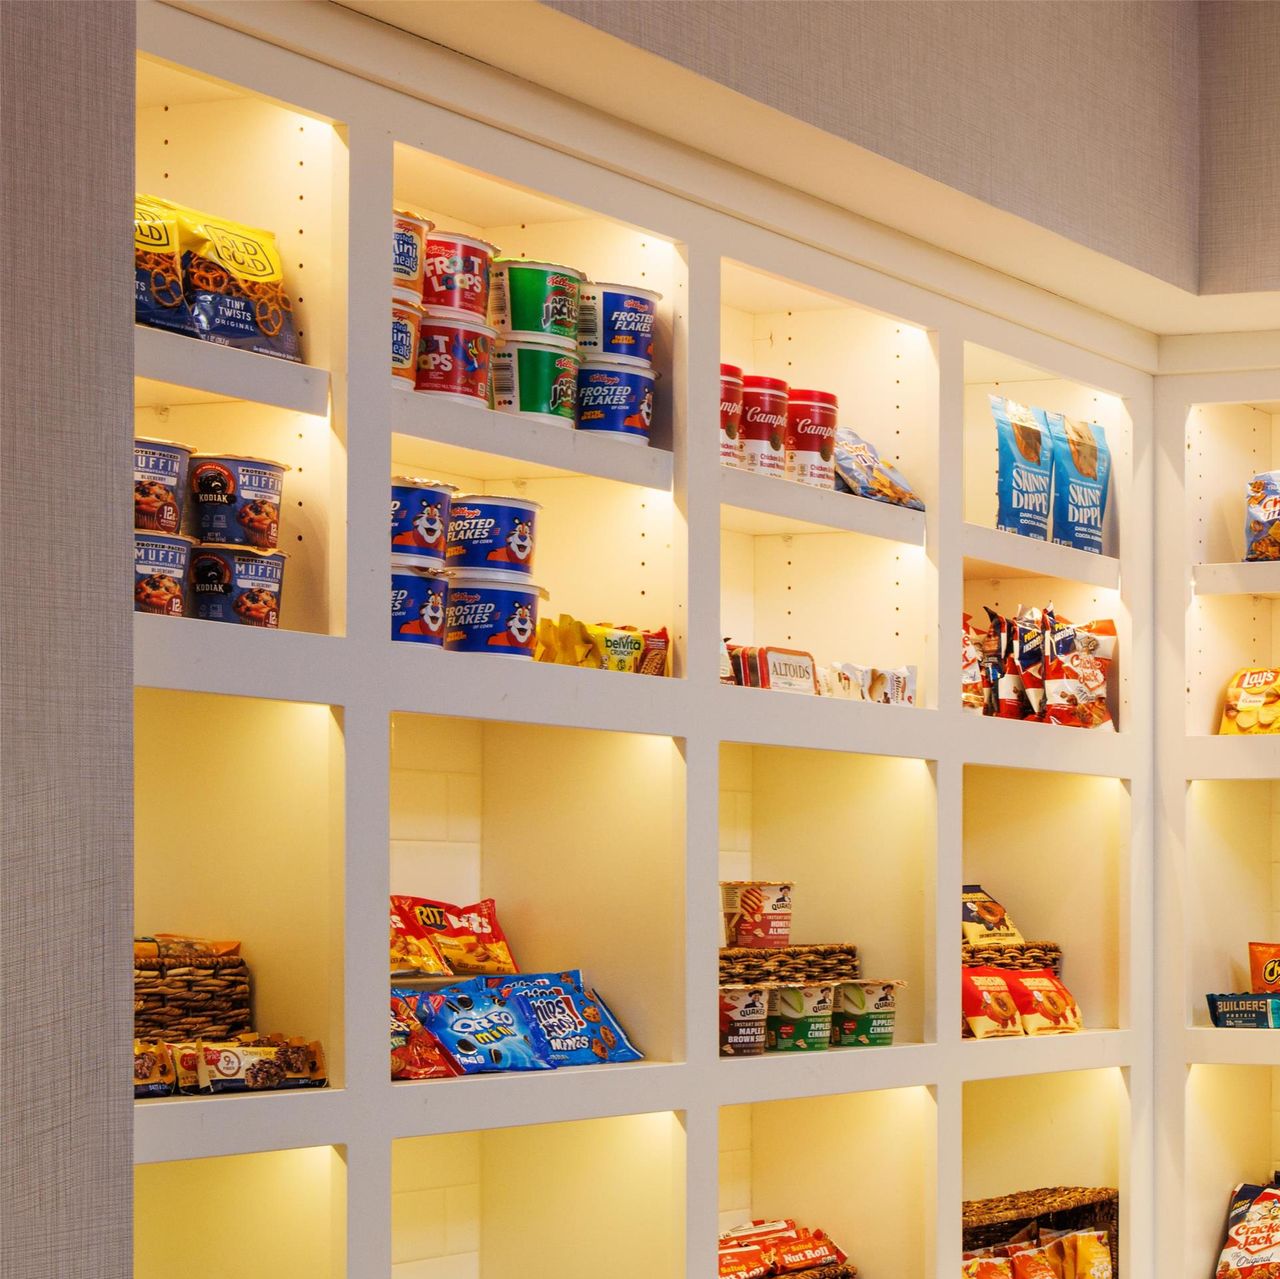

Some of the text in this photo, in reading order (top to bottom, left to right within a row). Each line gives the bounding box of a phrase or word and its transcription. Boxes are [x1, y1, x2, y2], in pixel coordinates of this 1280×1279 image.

[424, 255, 482, 278] FROOT
[431, 274, 483, 293] LOOPS
[226, 298, 246, 311] TINY
[218, 306, 253, 321] TWISTS
[611, 311, 655, 323] FROSTED
[215, 317, 255, 332] ORIGINAL
[614, 321, 652, 332] FLAKES
[580, 386, 632, 397] FROSTED
[582, 395, 627, 406] FLAKES
[138, 455, 180, 472] UFFIN
[199, 493, 228, 504] KODIAK
[449, 518, 495, 532] ROSTED
[135, 549, 186, 564] MUFFIN
[235, 563, 281, 579] MUFFIN
[196, 583, 224, 593] KODIAK
[447, 613, 490, 627] FLAKES
[771, 661, 811, 680] ALTOIDS
[1242, 670, 1276, 689] Lay's
[1217, 1000, 1267, 1012] BUILDERS
[452, 1011, 515, 1034] OREO
[1238, 1233, 1274, 1249] Jack
[783, 1252, 804, 1264] Nut
[805, 1246, 829, 1260] Roll
[1236, 1253, 1274, 1268] Original
